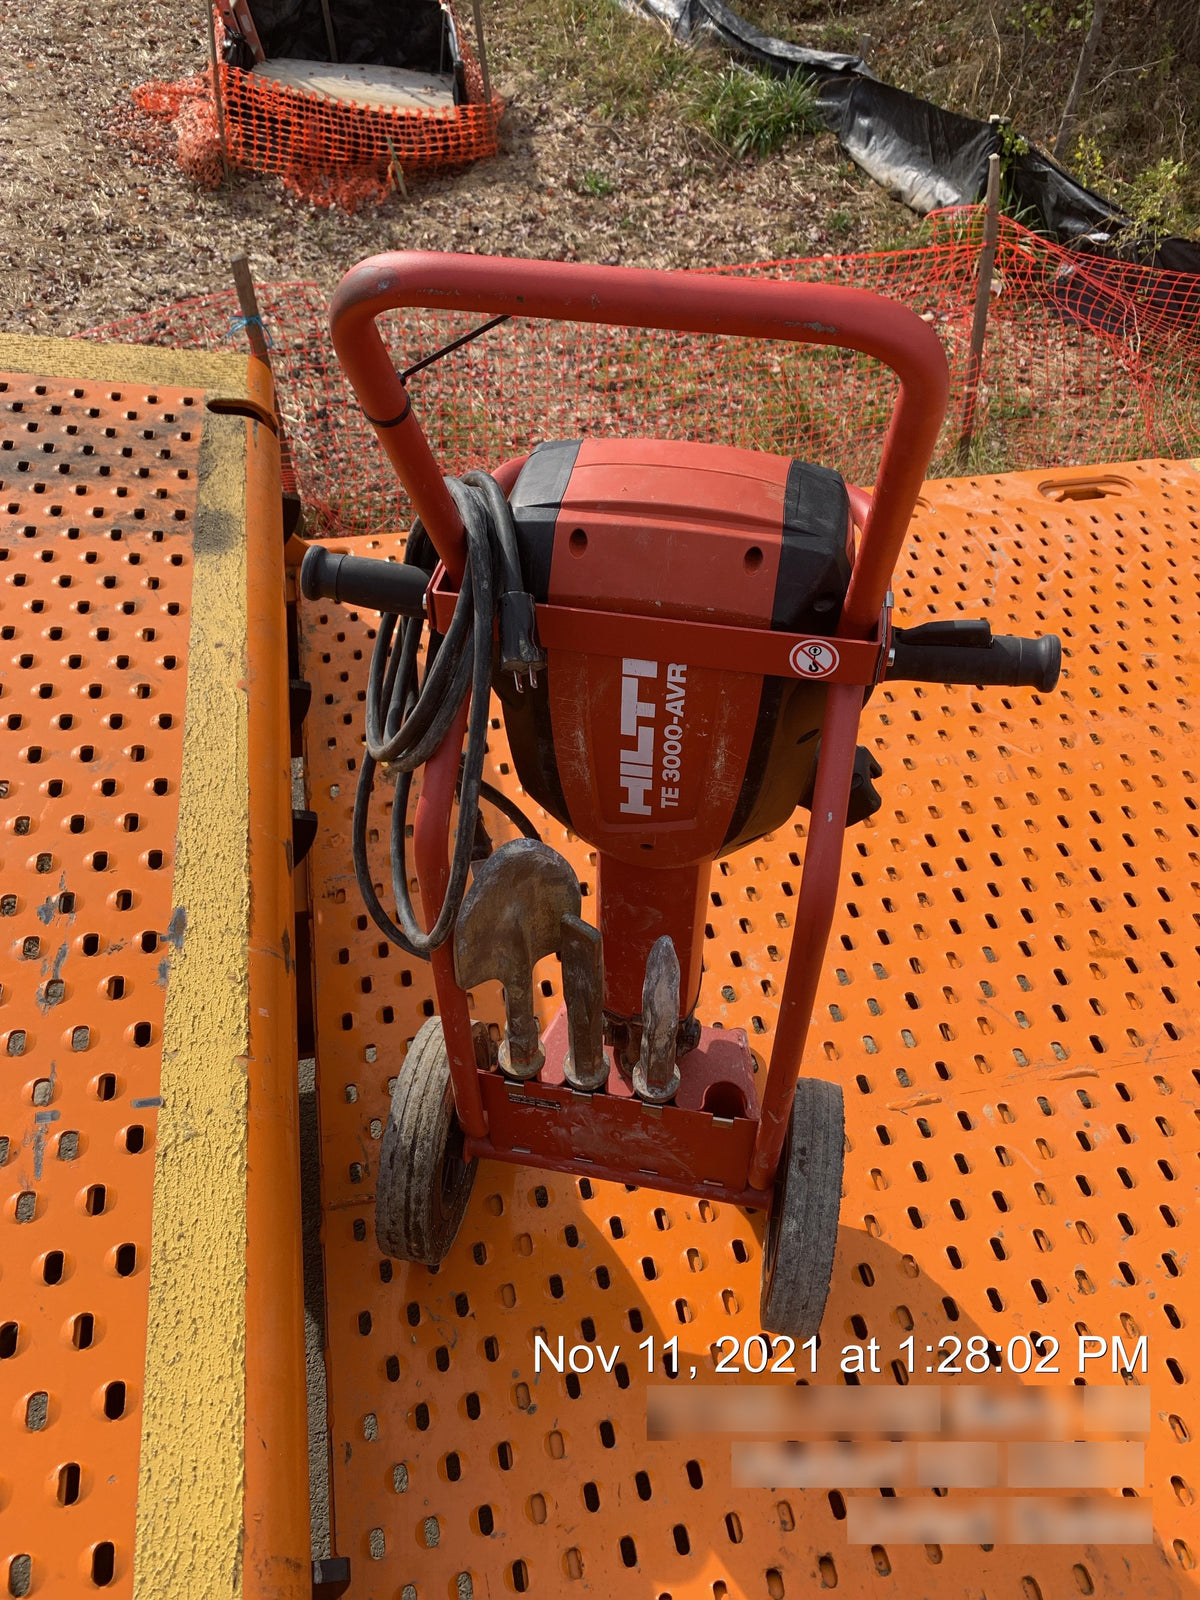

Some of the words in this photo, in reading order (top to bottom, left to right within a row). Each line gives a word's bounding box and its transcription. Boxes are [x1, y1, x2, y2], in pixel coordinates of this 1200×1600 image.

[620, 657, 658, 816] HILTI
[661, 662, 688, 783] 3000-AVR
[661, 786, 680, 808] TE
